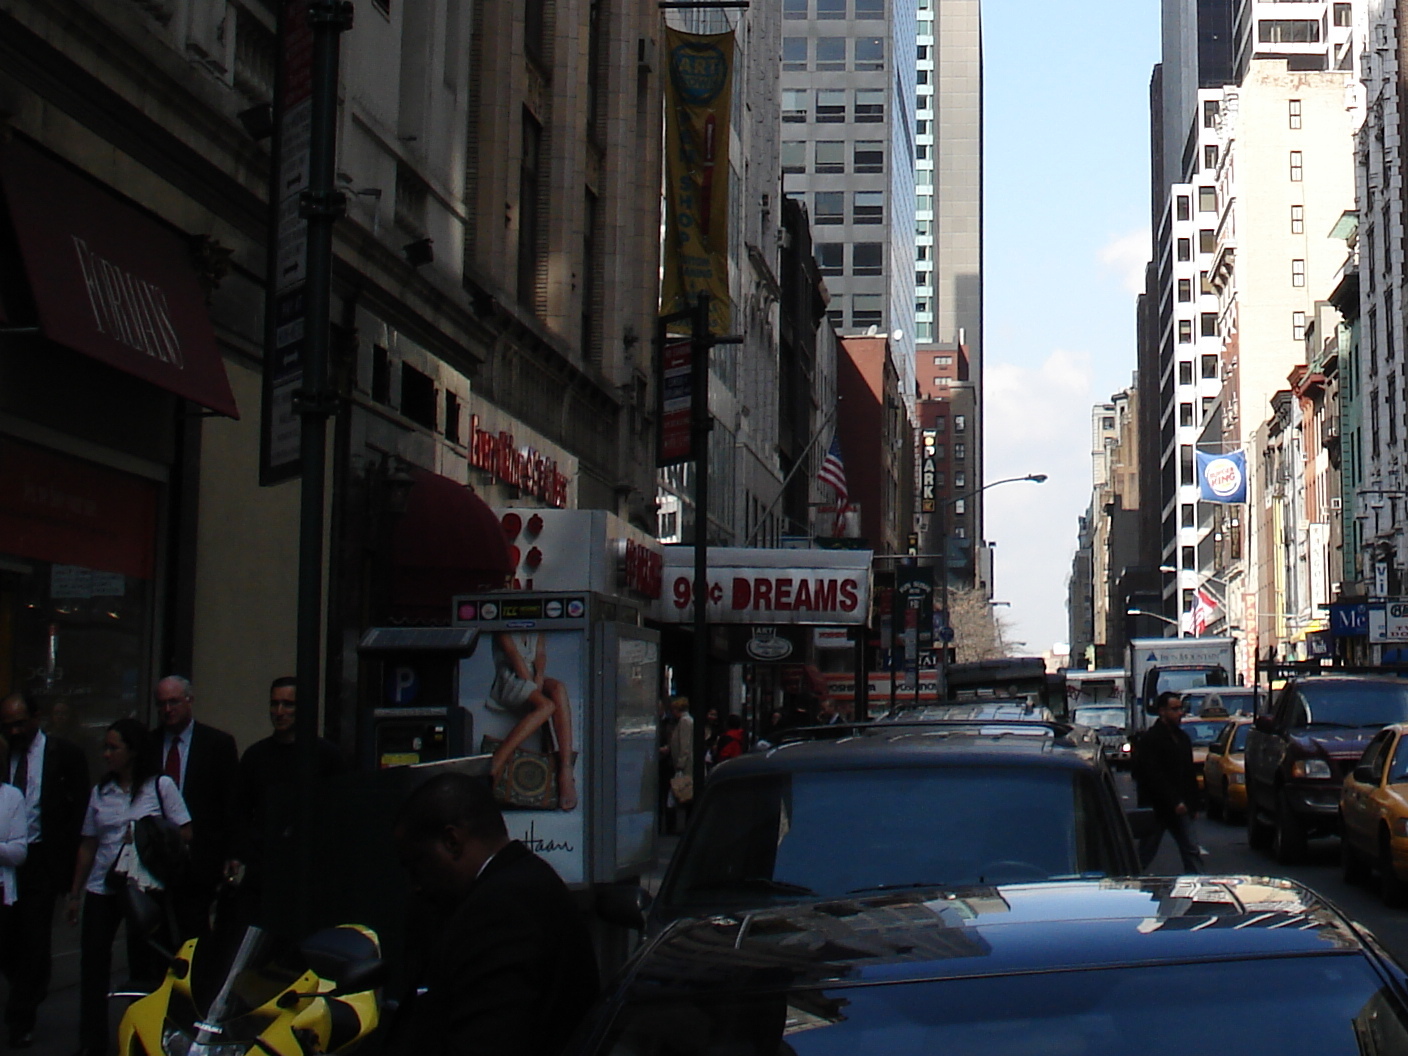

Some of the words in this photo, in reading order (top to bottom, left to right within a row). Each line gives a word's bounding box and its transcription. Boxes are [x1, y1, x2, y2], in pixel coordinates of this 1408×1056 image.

[923, 446, 936, 499] PARK
[1211, 472, 1236, 486] KING
[673, 577, 723, 609] 9¢
[732, 577, 858, 613] DREAMS
[396, 666, 415, 703] P
